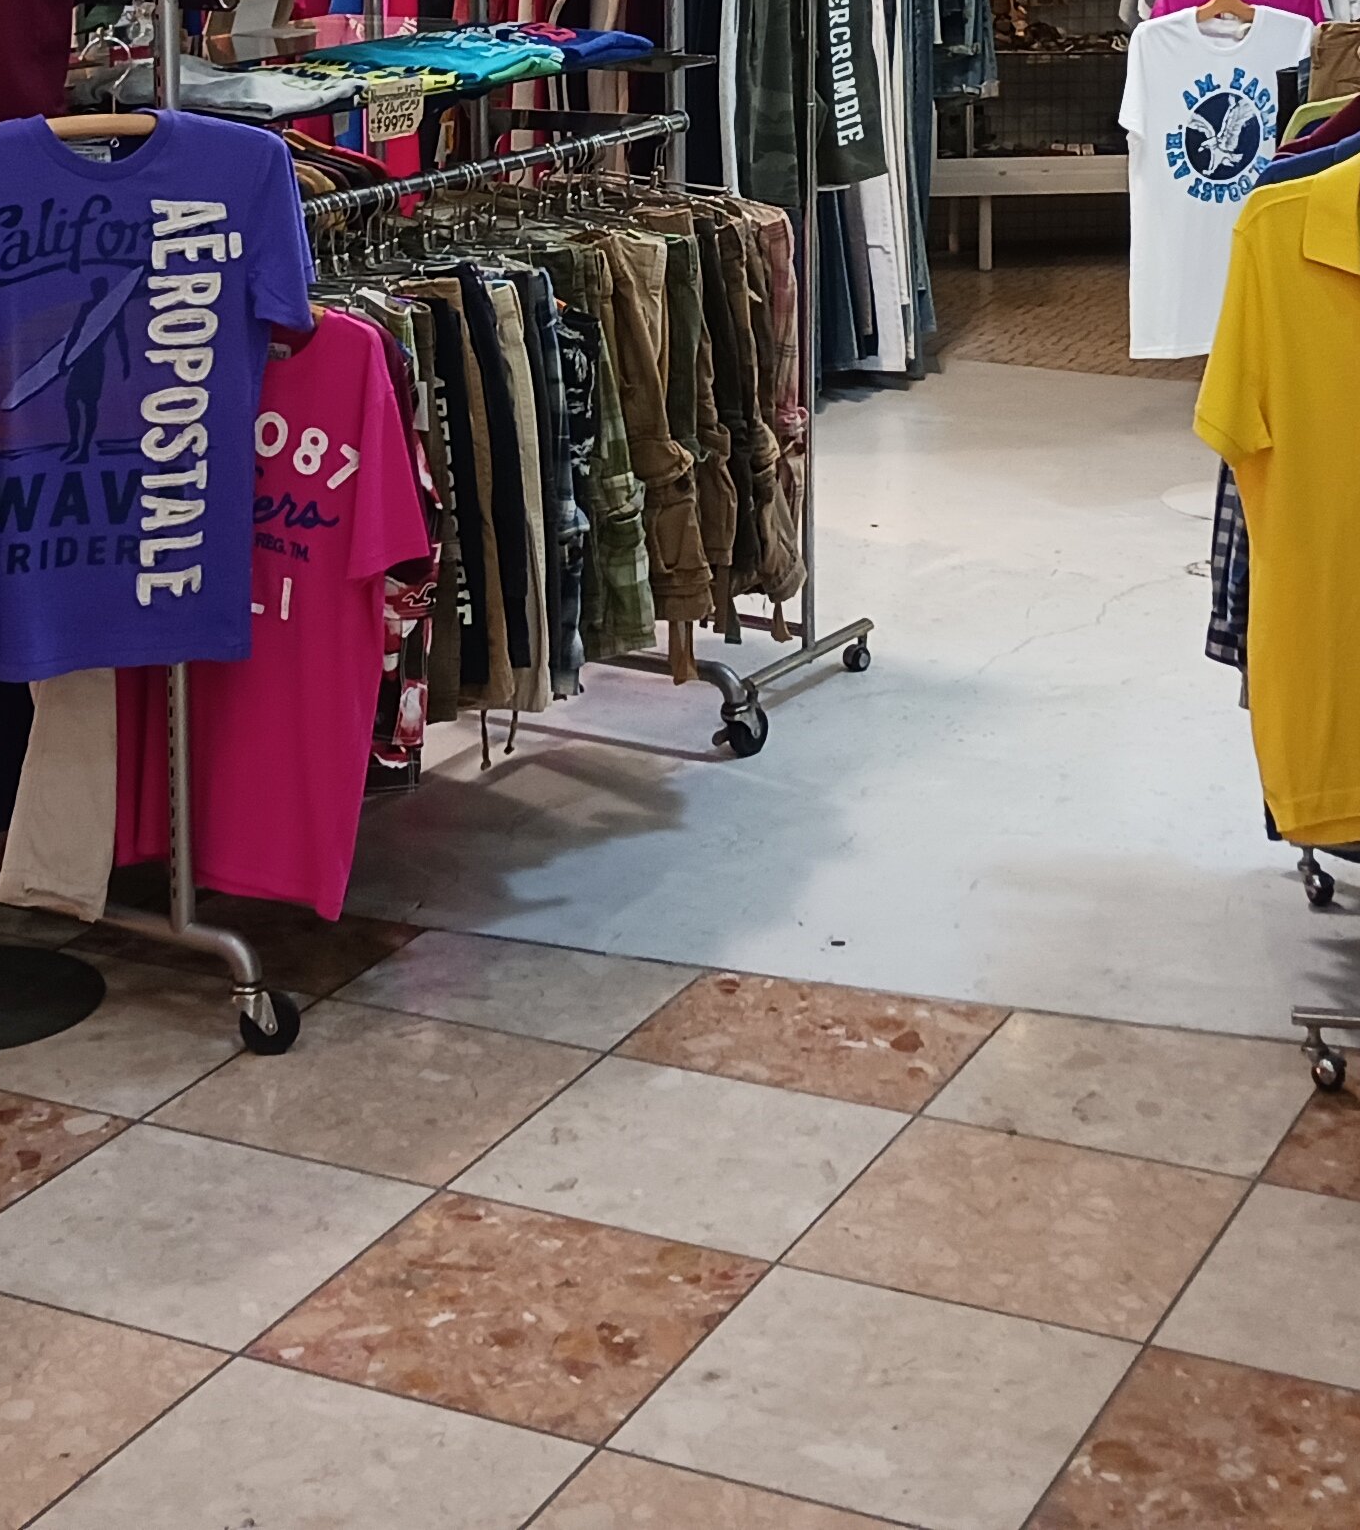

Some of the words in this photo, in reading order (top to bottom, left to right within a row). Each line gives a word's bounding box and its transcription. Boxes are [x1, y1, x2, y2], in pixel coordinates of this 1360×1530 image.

[376, 112, 414, 133] ¥9975
[1230, 67, 1277, 141] EAGLE
[6, 534, 158, 575] RIDER
